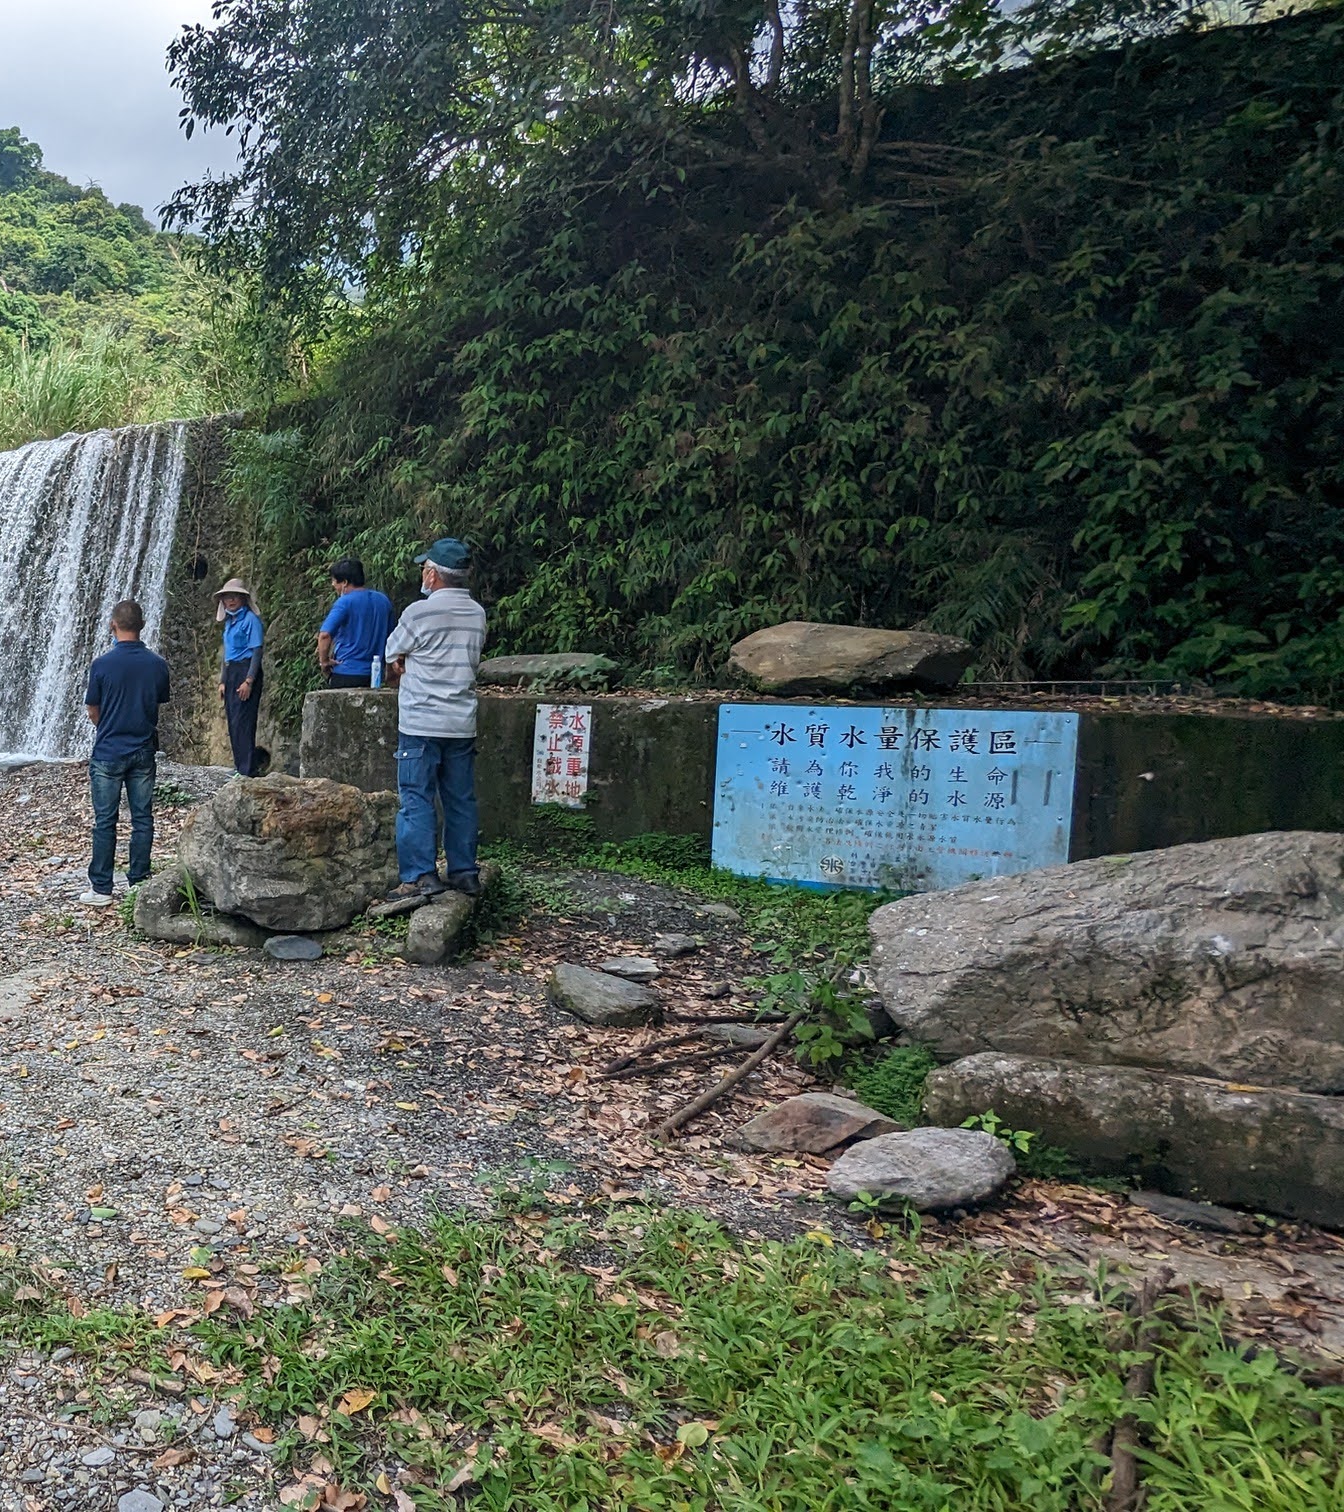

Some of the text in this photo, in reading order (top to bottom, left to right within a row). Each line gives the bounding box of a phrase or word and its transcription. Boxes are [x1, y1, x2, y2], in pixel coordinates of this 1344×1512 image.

[769, 722, 1018, 756] 水質水量保護區
[769, 757, 1009, 786] 請為你我的生命
[768, 780, 1006, 810] 維護乾淨的水源
